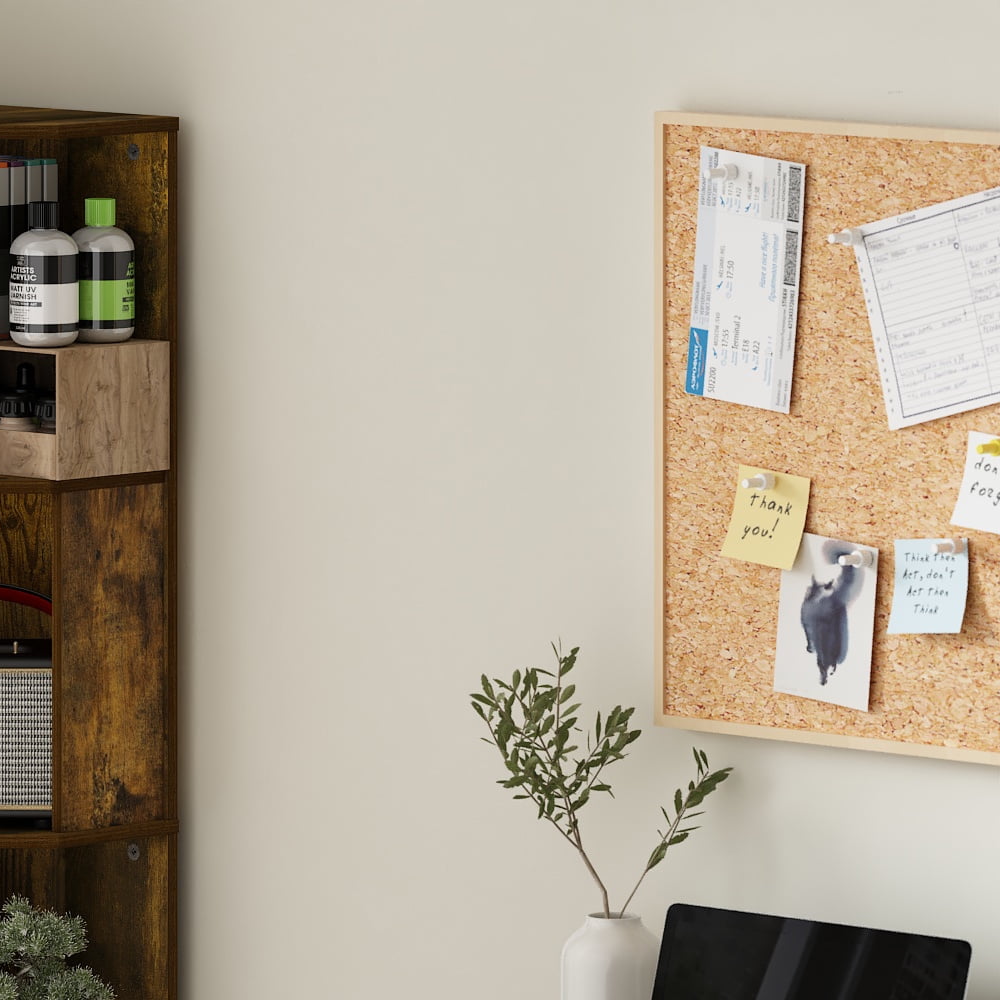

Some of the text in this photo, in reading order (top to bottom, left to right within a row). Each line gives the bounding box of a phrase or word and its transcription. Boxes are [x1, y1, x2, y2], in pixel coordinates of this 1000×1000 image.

[11, 265, 35, 274] ARTISTS
[11, 273, 37, 281] ACRYLIC
[726, 260, 735, 279] 17:50
[721, 329, 729, 347] 17:55
[731, 320, 741, 350] Terminal
[752, 340, 760, 354] A22
[708, 366, 717, 393] SU2200
[741, 517, 779, 540] you!
